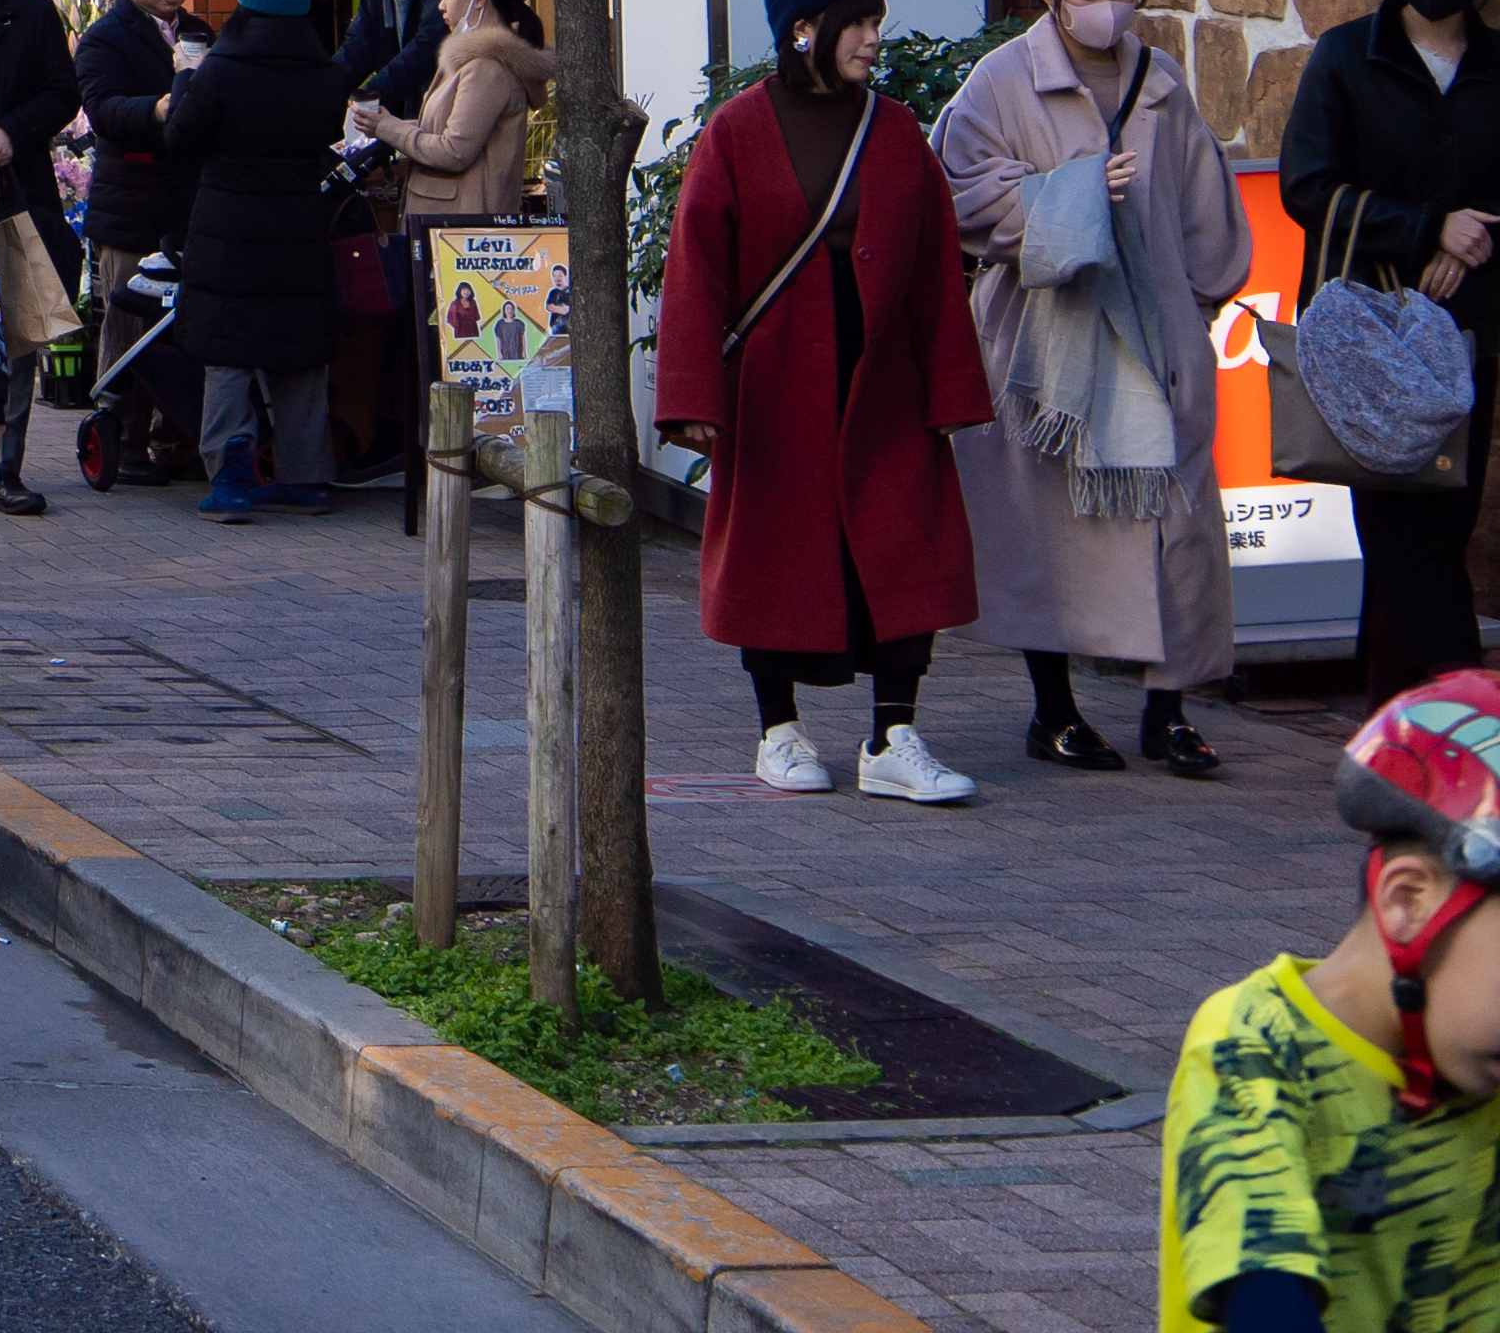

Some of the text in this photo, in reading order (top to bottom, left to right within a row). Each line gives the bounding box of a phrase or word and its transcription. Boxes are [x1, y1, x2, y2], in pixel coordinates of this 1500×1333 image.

[467, 237, 513, 253] Lévi
[1226, 498, 1315, 524] ショップ
[1229, 532, 1267, 550] 楽坂
